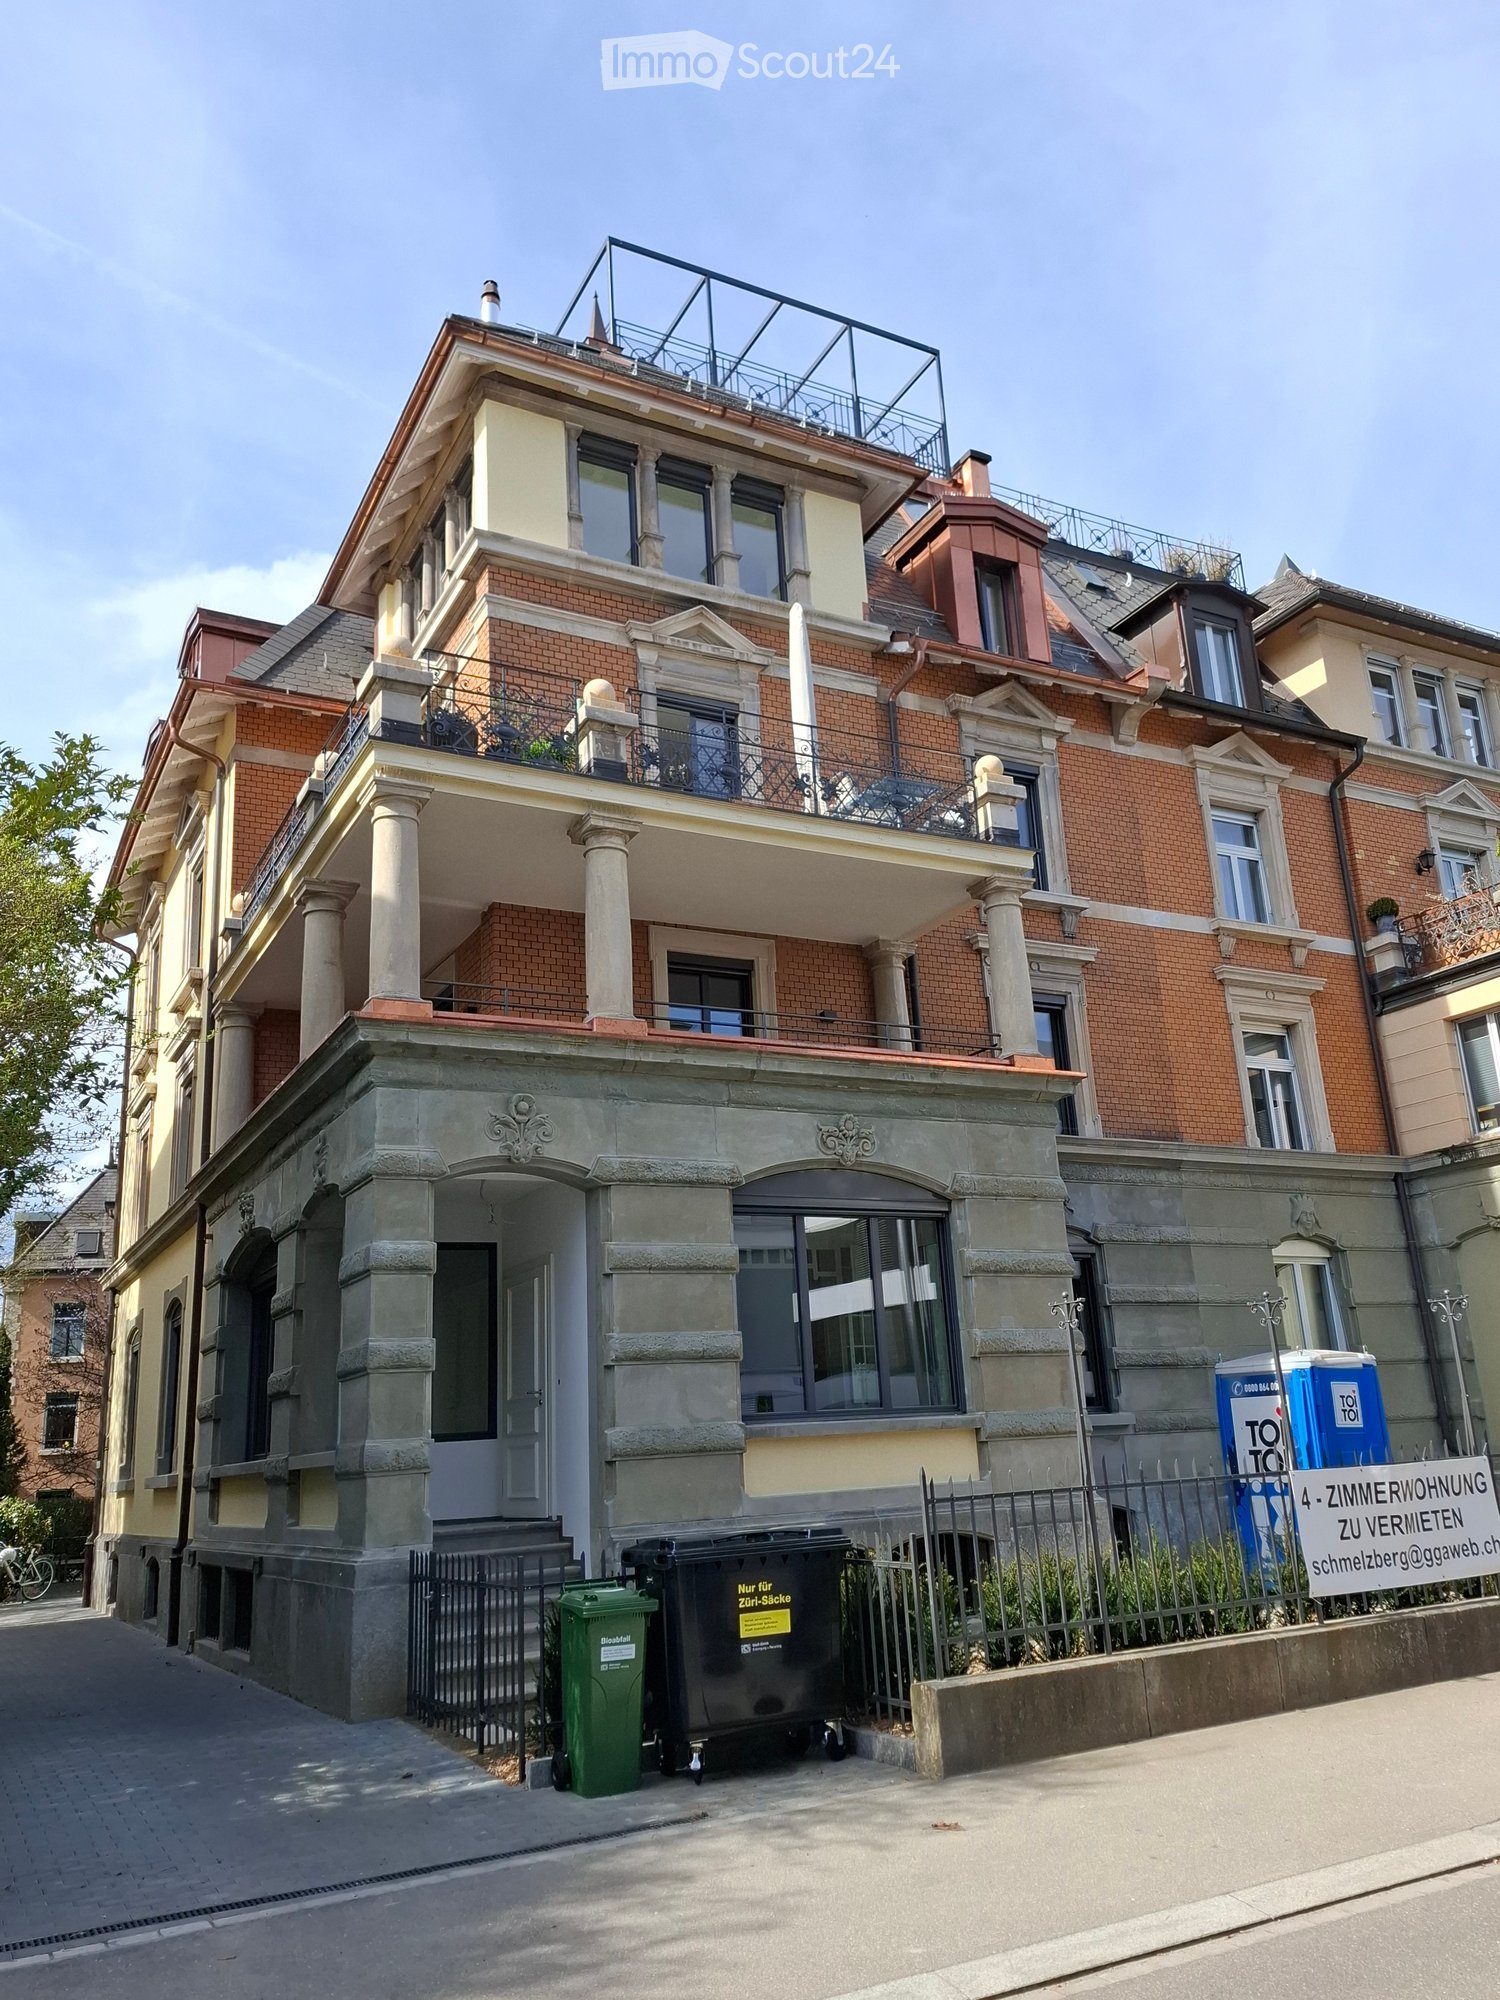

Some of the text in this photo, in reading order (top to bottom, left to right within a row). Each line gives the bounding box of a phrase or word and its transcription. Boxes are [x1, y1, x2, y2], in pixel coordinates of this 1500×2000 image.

[1341, 1408, 1360, 1422] TOI
[1301, 1486, 1311, 1510] 4
[1325, 1471, 1488, 1508] ZIMMERWOHNUNG
[1338, 1507, 1464, 1541] ZU VERMIETEN
[1312, 1534, 1500, 1576] schmelzberg@ggaweb.ch
[738, 1581, 772, 1594] Nur für
[738, 1593, 791, 1608] Züri-Säcke
[600, 1634, 631, 1645] Bioabfall
